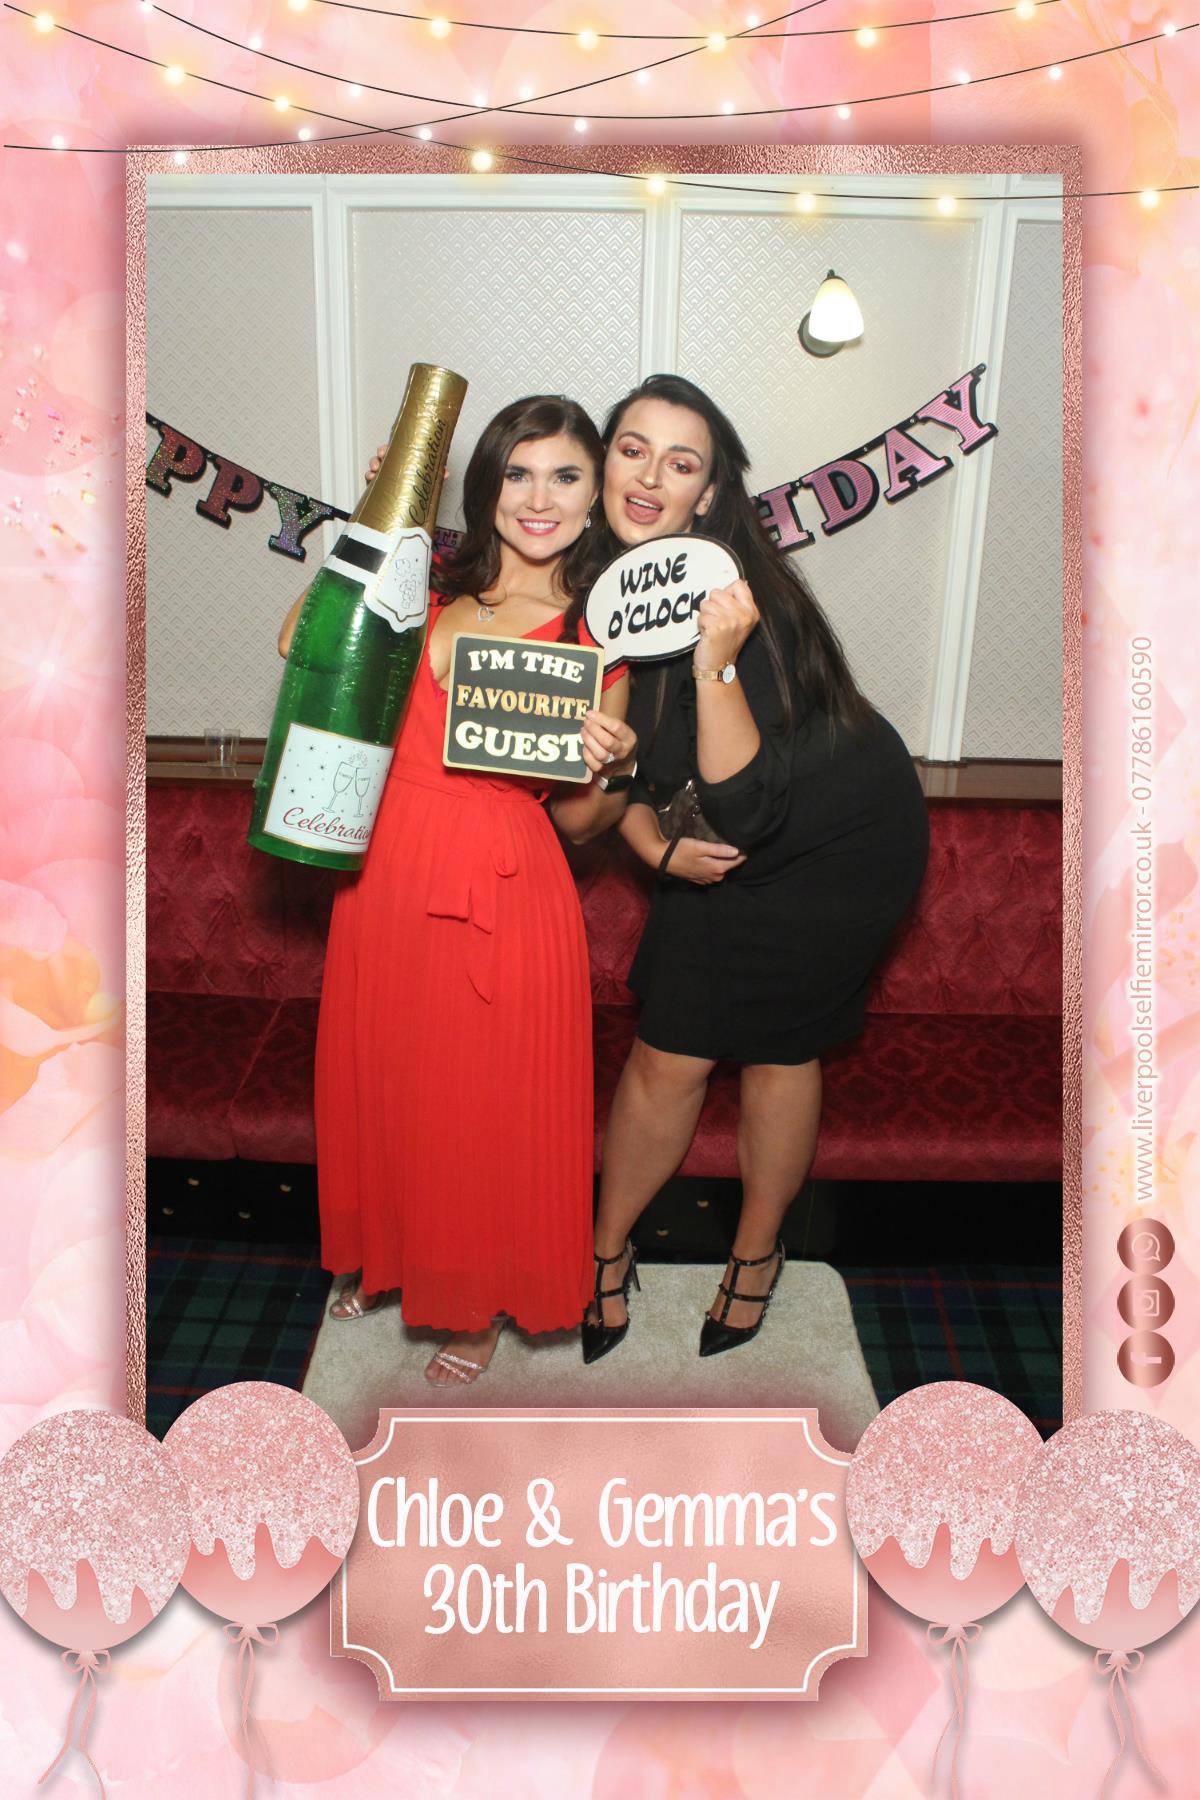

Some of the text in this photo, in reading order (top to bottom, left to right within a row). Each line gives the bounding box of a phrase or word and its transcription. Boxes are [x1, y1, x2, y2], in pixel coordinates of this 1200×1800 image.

[408, 418, 446, 526] Celebration
[620, 552, 688, 598] WINE
[607, 589, 707, 640] O'CLOCK
[467, 649, 585, 684] I'M THE
[455, 684, 591, 721] FAVOURITE
[454, 720, 585, 763] GUEST
